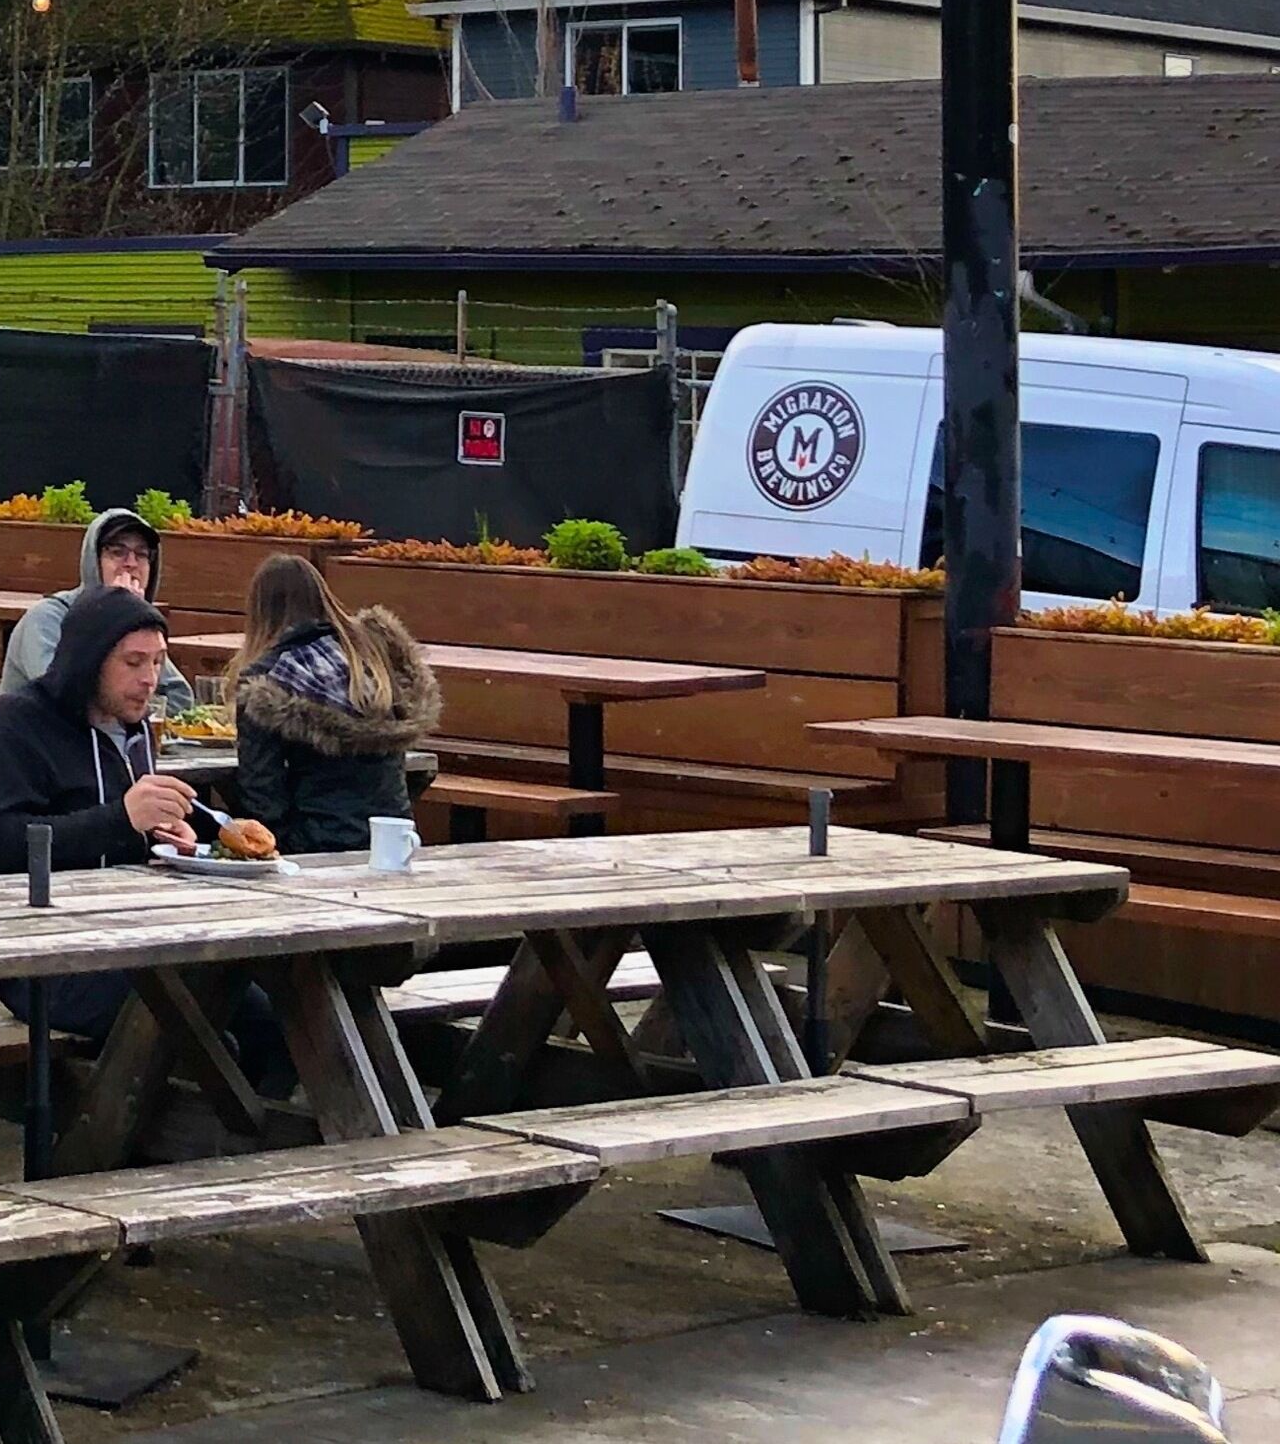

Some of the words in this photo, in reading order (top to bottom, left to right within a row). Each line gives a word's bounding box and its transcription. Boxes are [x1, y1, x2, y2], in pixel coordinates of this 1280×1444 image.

[762, 391, 857, 439] MIGRATION
[787, 426, 824, 464] M
[756, 448, 834, 502] BREWING
